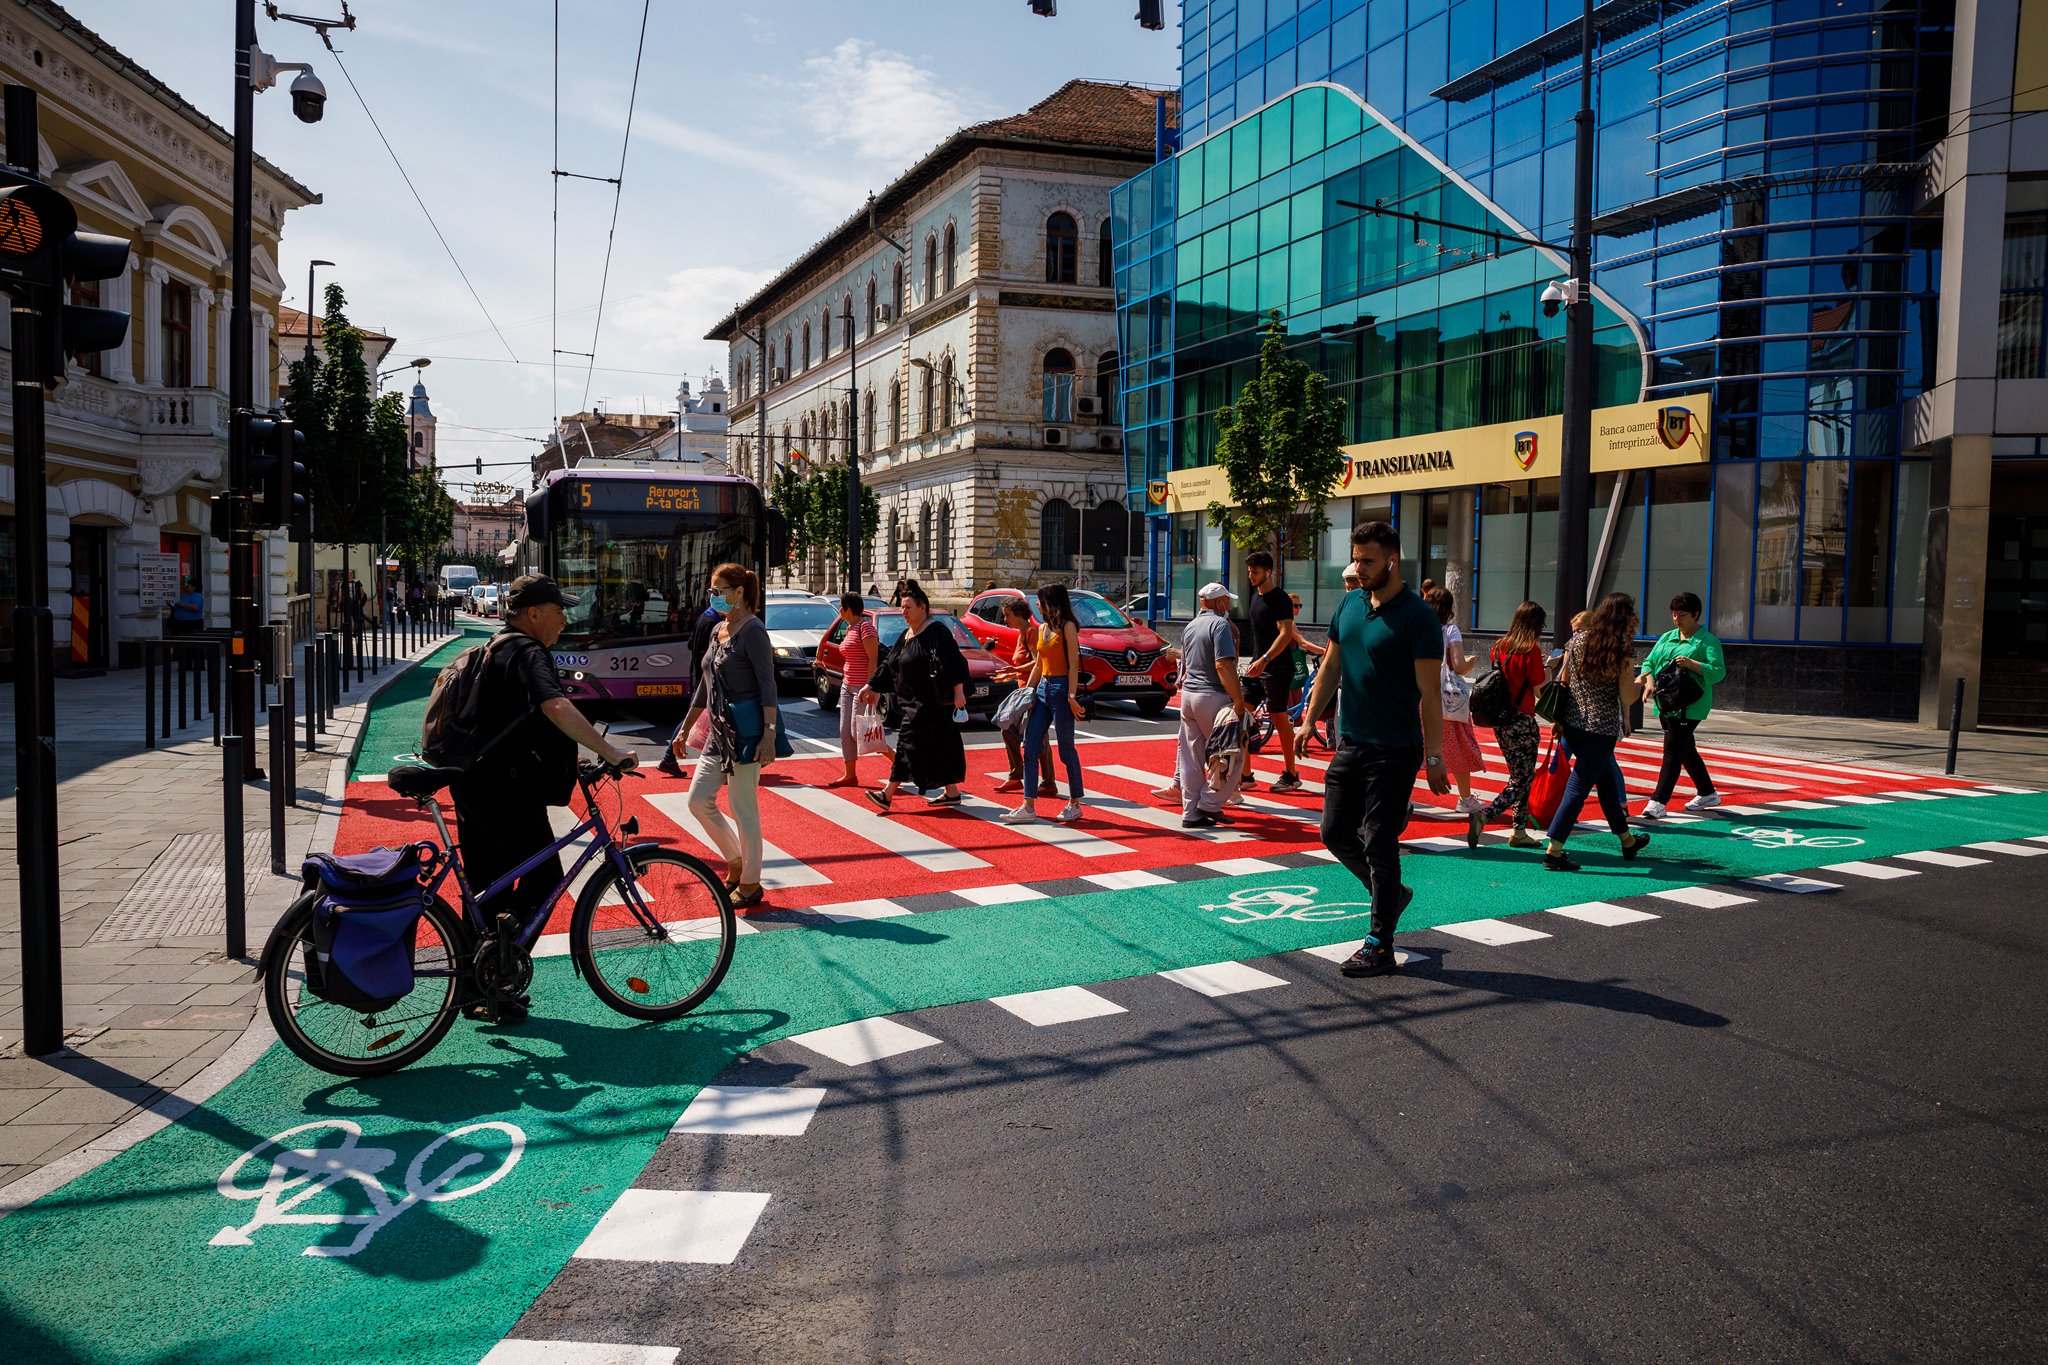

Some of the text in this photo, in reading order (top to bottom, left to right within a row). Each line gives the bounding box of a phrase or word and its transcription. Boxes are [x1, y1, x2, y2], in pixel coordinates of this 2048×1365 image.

[1600, 419, 1659, 436] Banca oameni
[1670, 416, 1686, 430] BT
[1518, 440, 1532, 452] BT
[1608, 435, 1663, 450] întreprinzăto
[1355, 450, 1454, 478] TRANSILVANIA
[581, 483, 592, 508] 5
[649, 485, 698, 499] Aeroport
[1153, 484, 1165, 493] BT
[675, 498, 700, 510] Garii
[610, 656, 639, 671] 312
[864, 725, 883, 742] H&M
